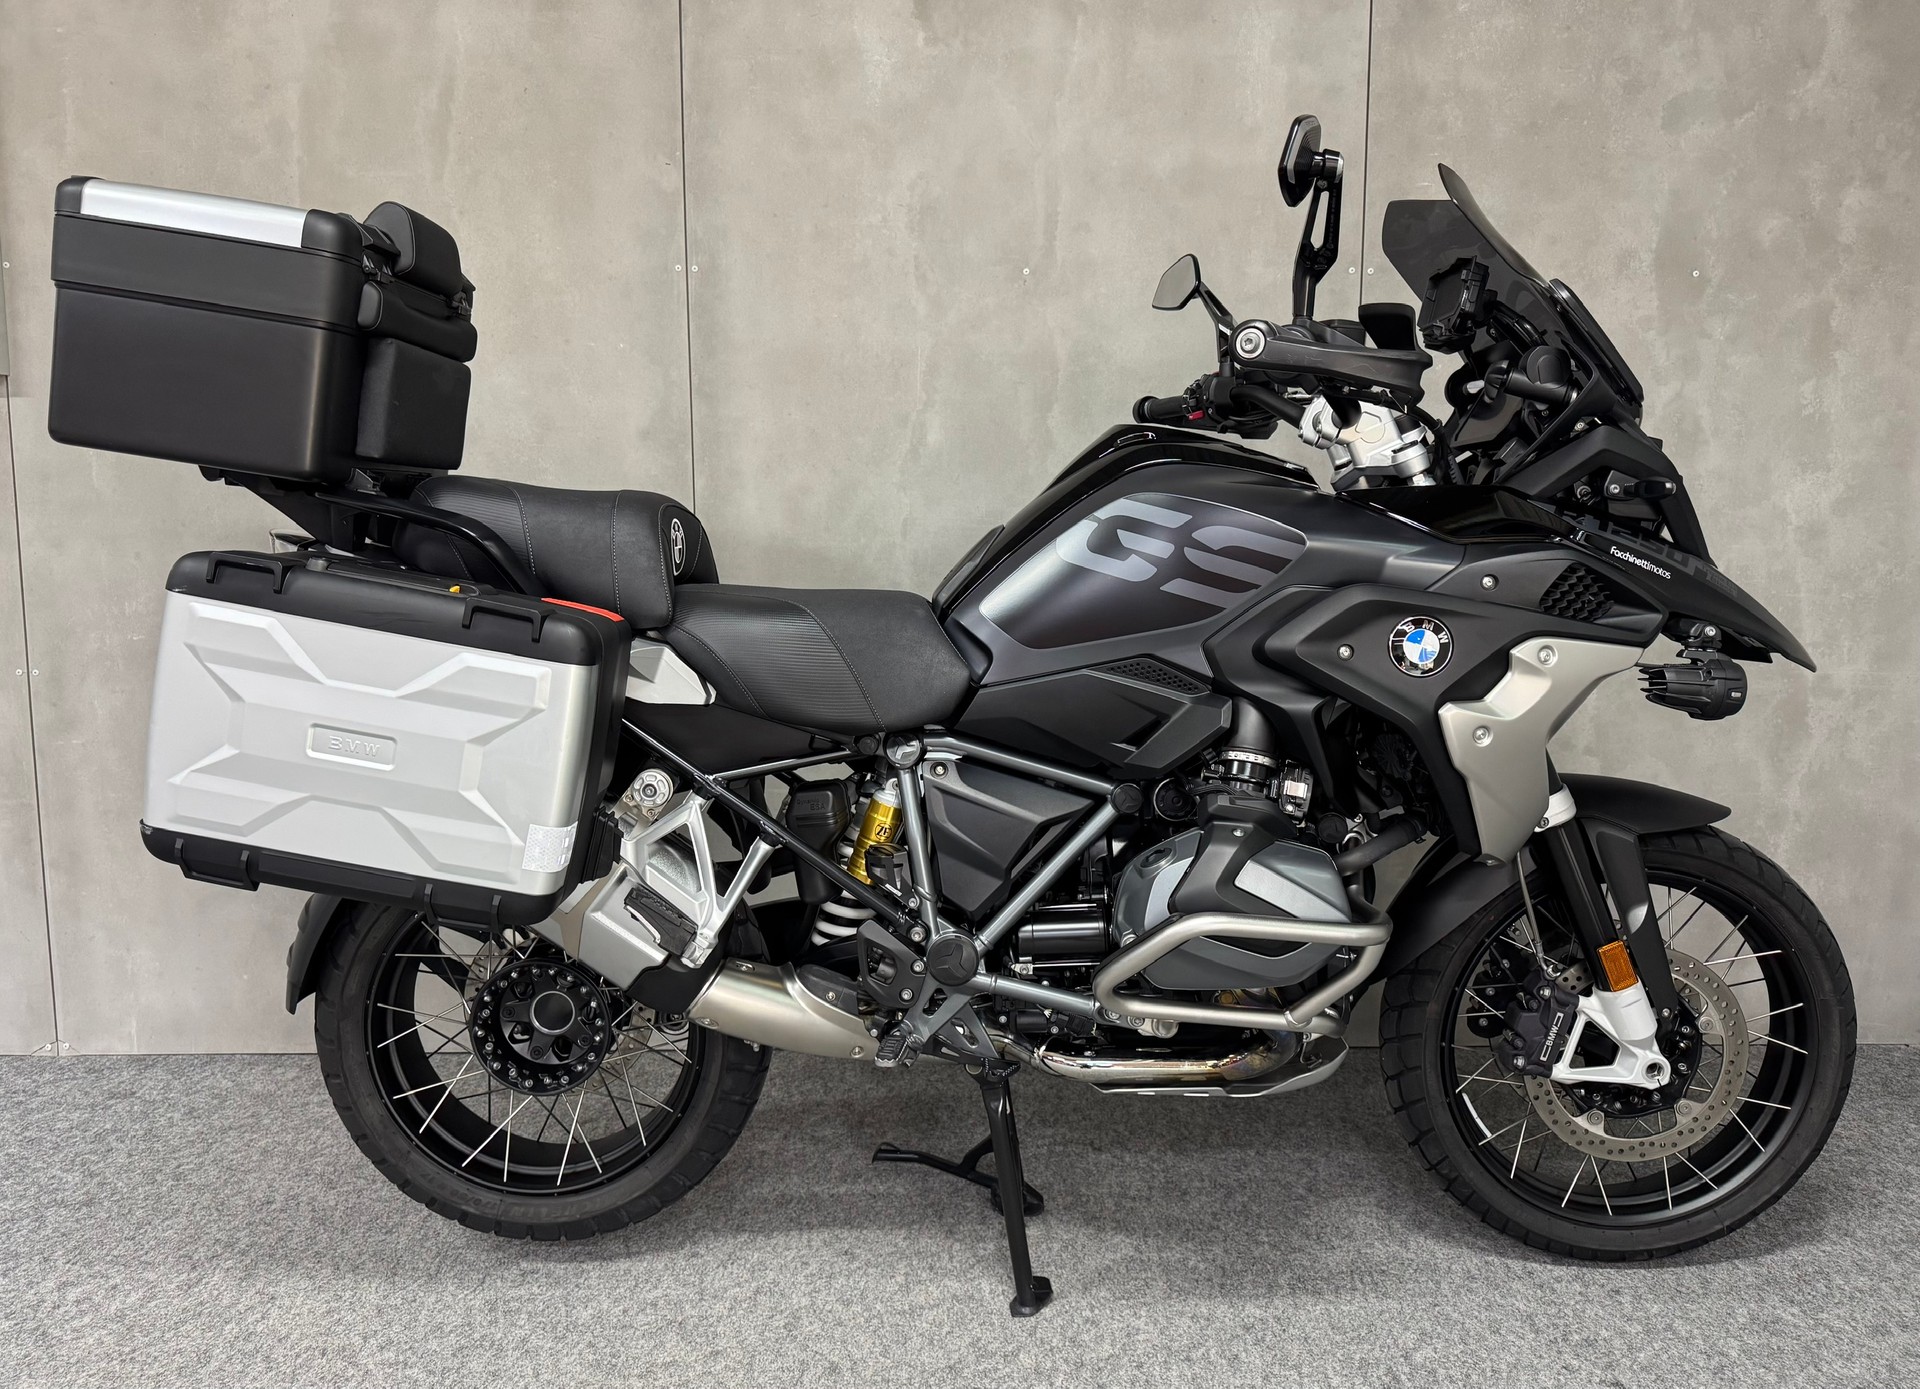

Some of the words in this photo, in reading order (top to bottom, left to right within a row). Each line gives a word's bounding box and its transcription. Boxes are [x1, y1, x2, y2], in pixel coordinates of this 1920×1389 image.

[1055, 498, 1307, 610] GS
[1403, 619, 1448, 643] BMW
[328, 735, 380, 757] BMW
[876, 825, 891, 837] ZF
[1545, 1024, 1559, 1046] BMW
